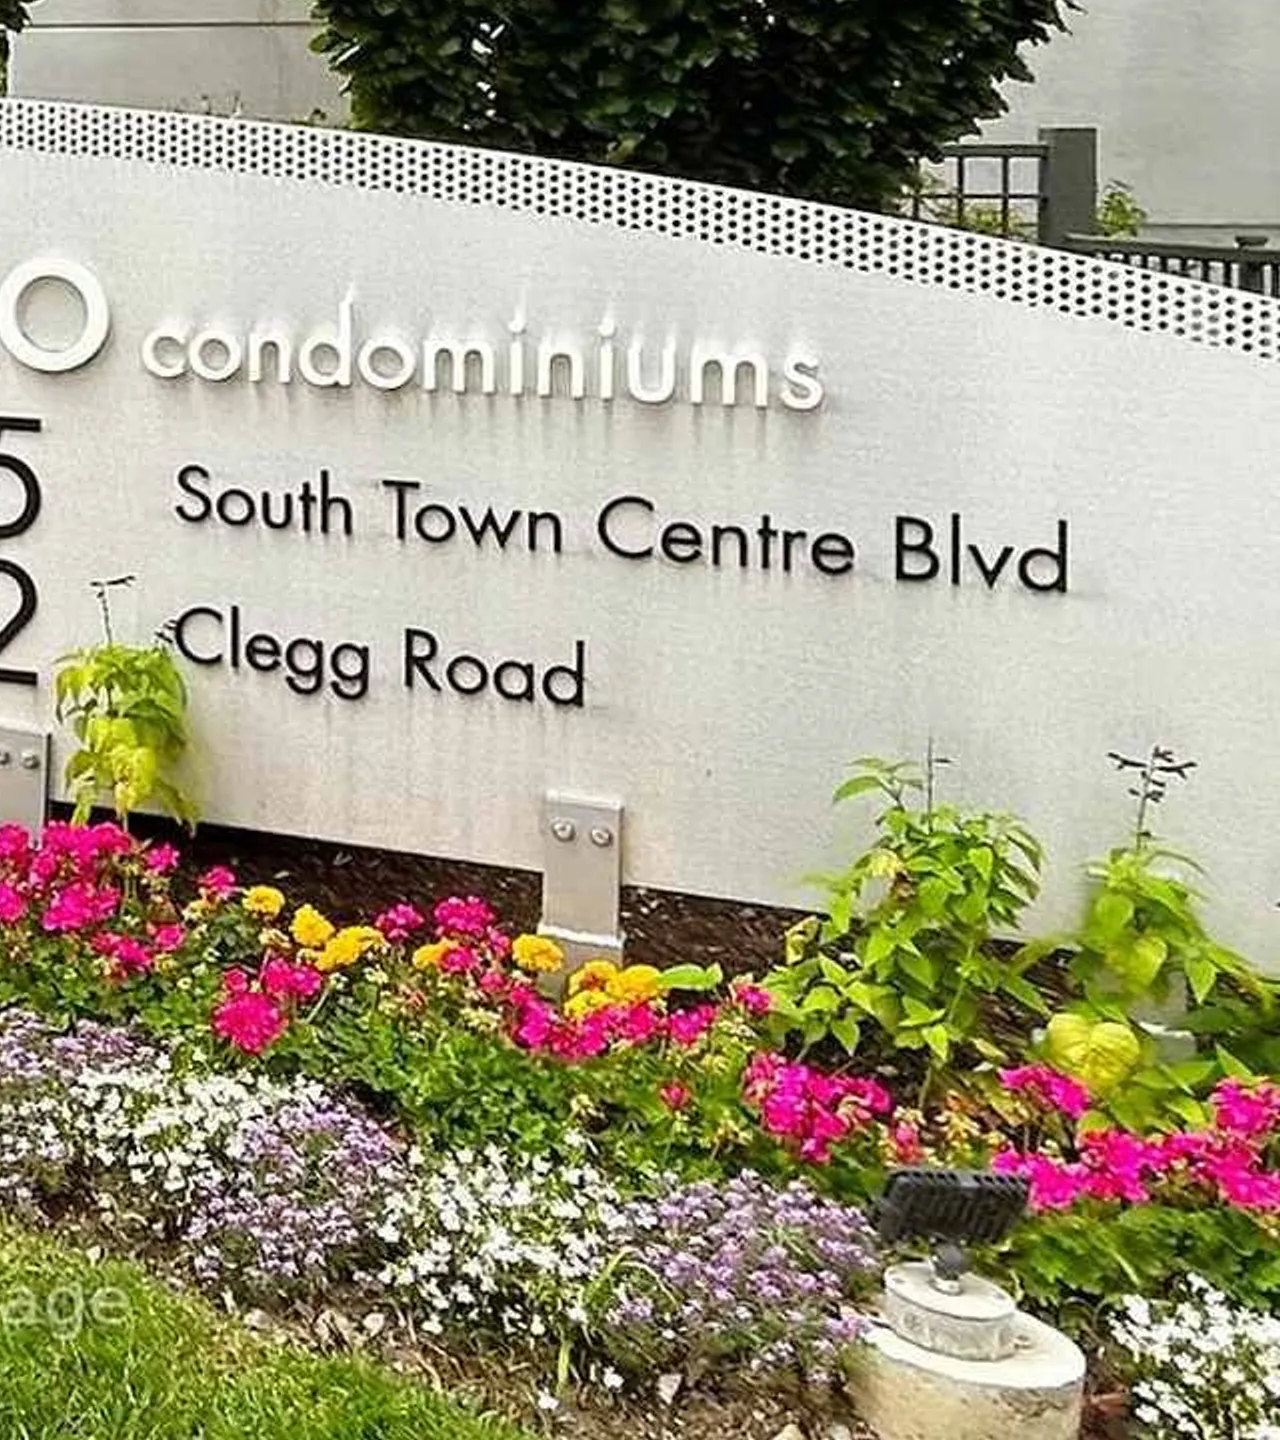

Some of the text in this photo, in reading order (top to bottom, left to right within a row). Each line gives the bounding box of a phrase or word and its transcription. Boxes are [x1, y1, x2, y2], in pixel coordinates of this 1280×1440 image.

[142, 290, 825, 411] condominiums
[174, 463, 1072, 596] South Town Centre Blvd
[172, 605, 587, 709] Clegg Road
